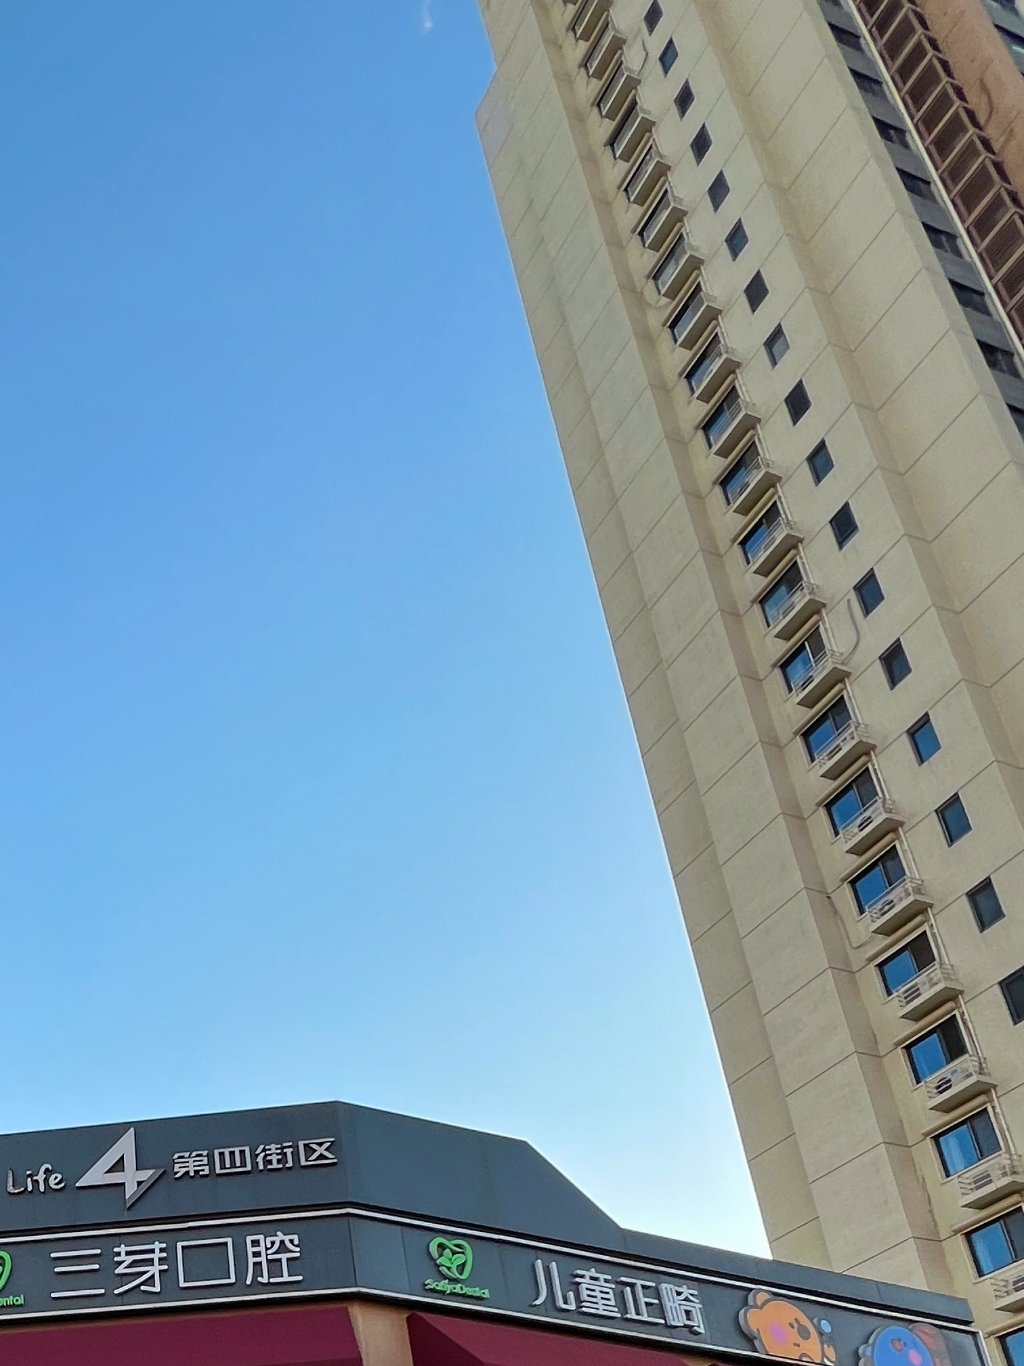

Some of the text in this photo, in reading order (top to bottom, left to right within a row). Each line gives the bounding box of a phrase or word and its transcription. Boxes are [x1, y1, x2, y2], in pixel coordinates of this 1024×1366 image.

[6, 1163, 66, 1195] Life
[76, 1127, 166, 1208] 4
[172, 1137, 338, 1178] 第四街区
[49, 1231, 304, 1298] 三芽口腔
[532, 1259, 705, 1335] 儿童正畸
